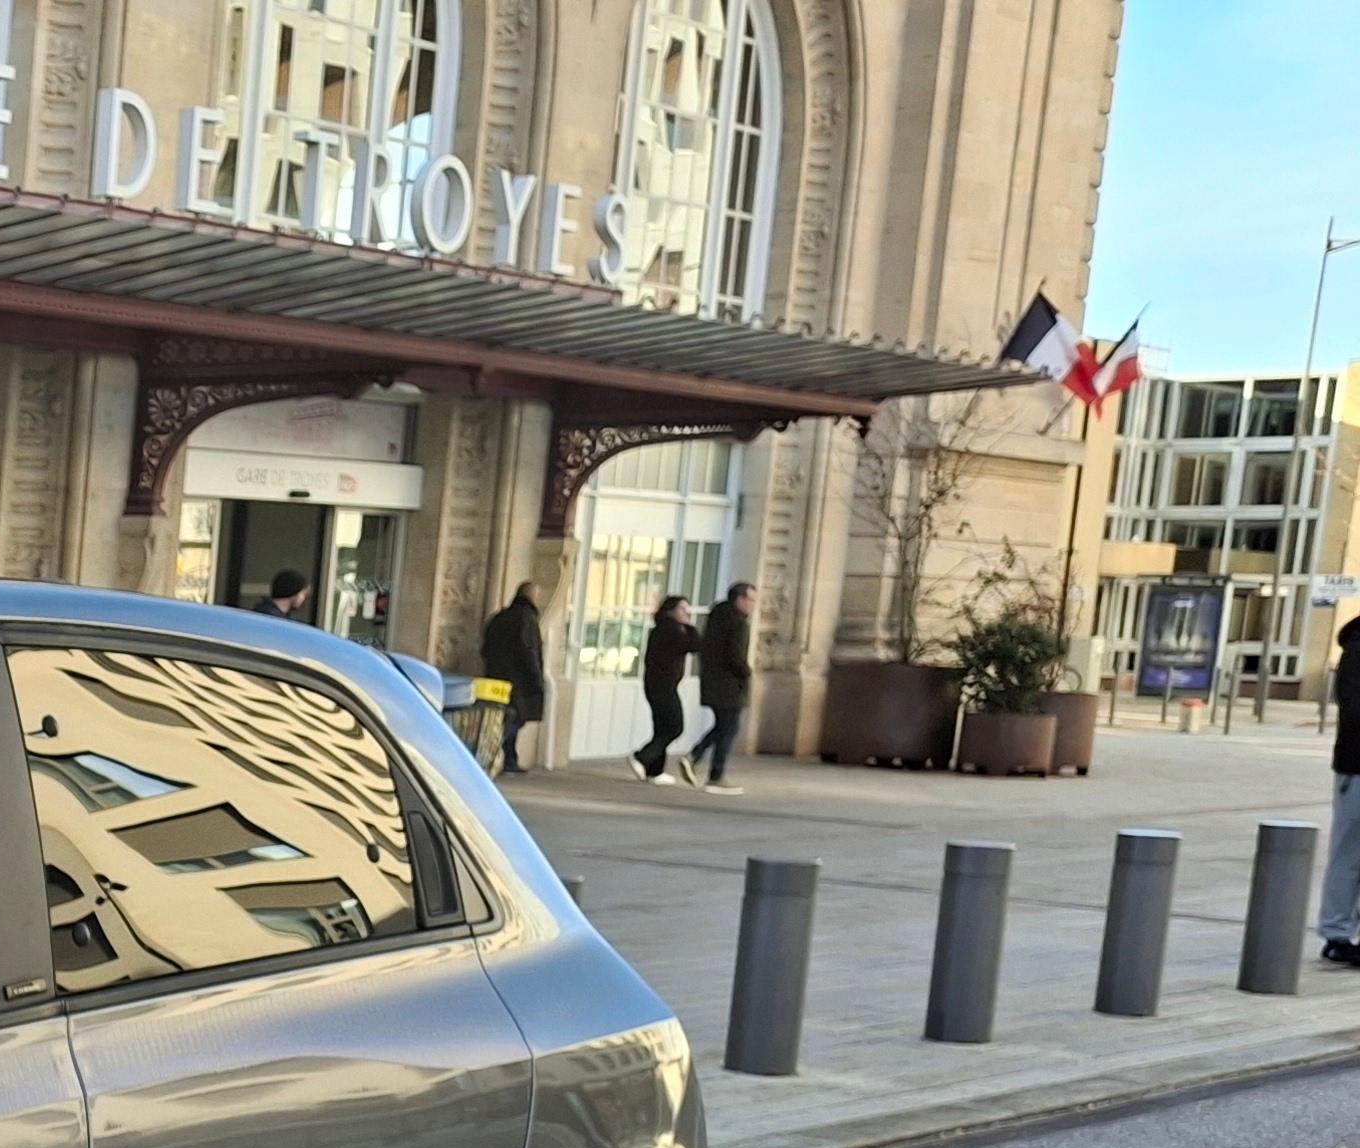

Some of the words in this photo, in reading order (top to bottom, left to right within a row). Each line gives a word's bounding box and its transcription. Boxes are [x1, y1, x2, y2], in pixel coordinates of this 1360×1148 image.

[92, 87, 226, 216] DE
[295, 129, 627, 284] TROYES
[235, 467, 269, 486] GARE
